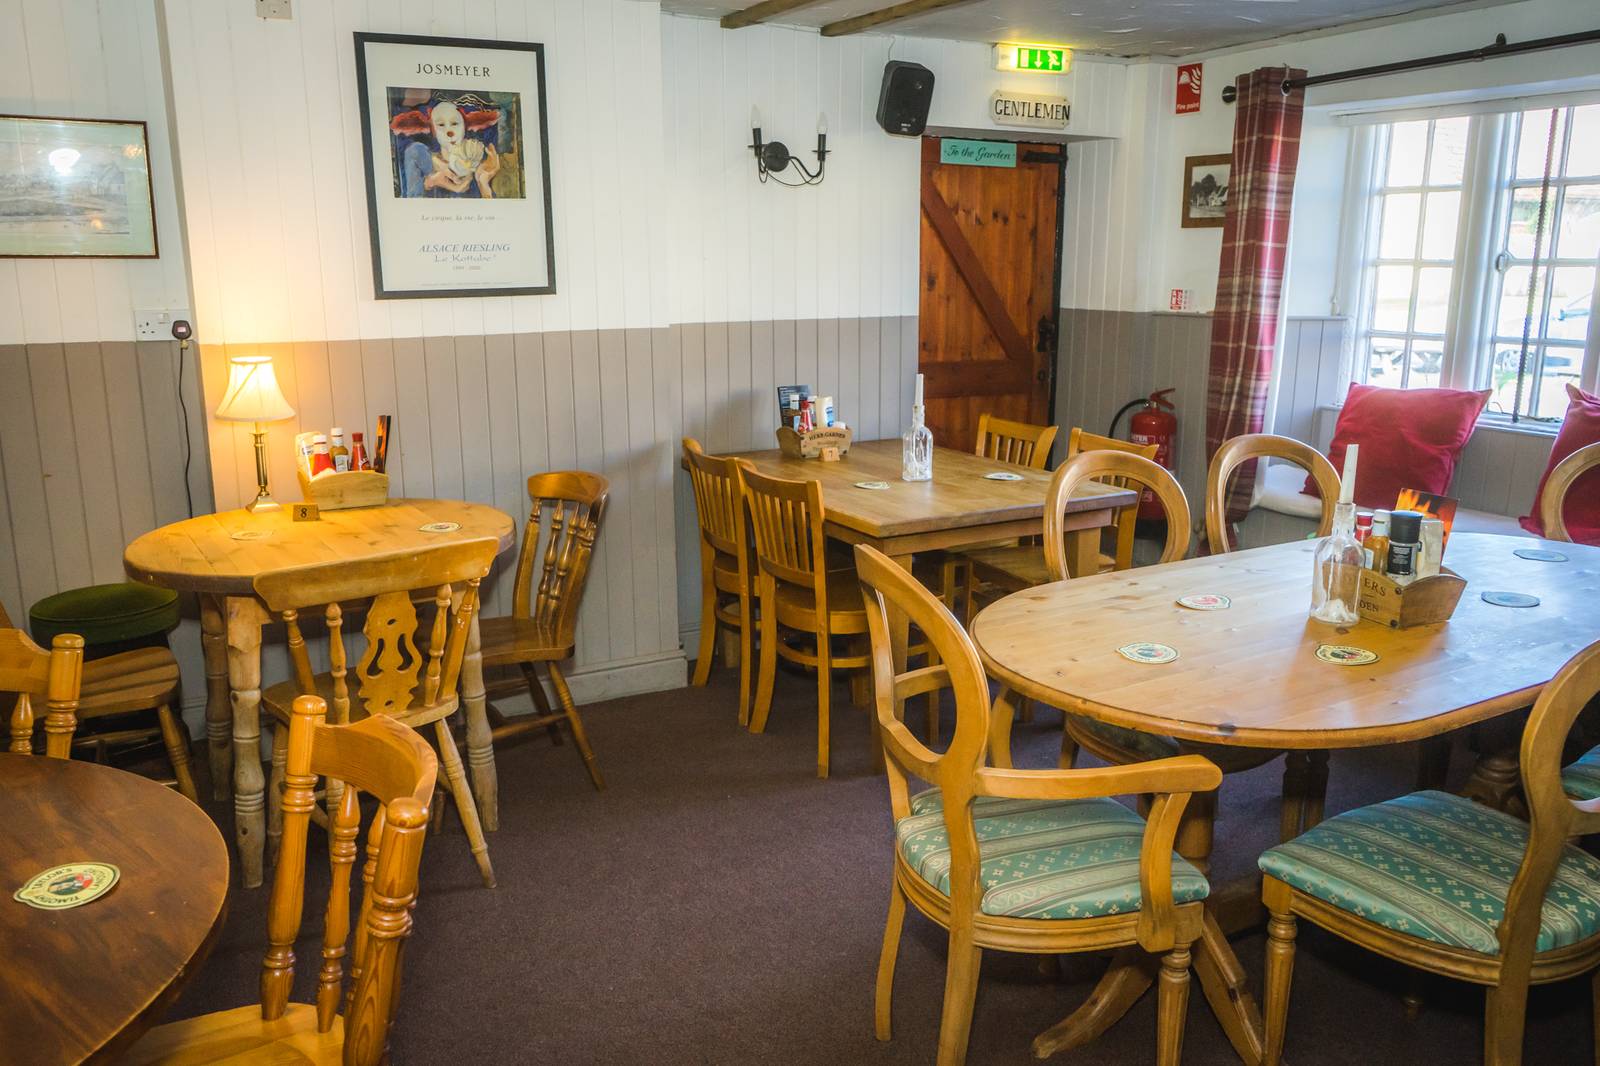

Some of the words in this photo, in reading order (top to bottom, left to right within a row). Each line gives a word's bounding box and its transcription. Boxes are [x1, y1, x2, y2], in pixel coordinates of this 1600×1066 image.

[416, 63, 490, 77] JOSMEYER
[994, 98, 1070, 120] GENTLEMEN
[946, 144, 959, 157] To
[960, 146, 974, 158] the
[975, 146, 1011, 162] Garden
[419, 244, 459, 252] ALSACE
[462, 243, 510, 252] RIESLING
[300, 507, 308, 519] 8
[1364, 578, 1386, 596] ERS
[1360, 600, 1378, 612] DEN
